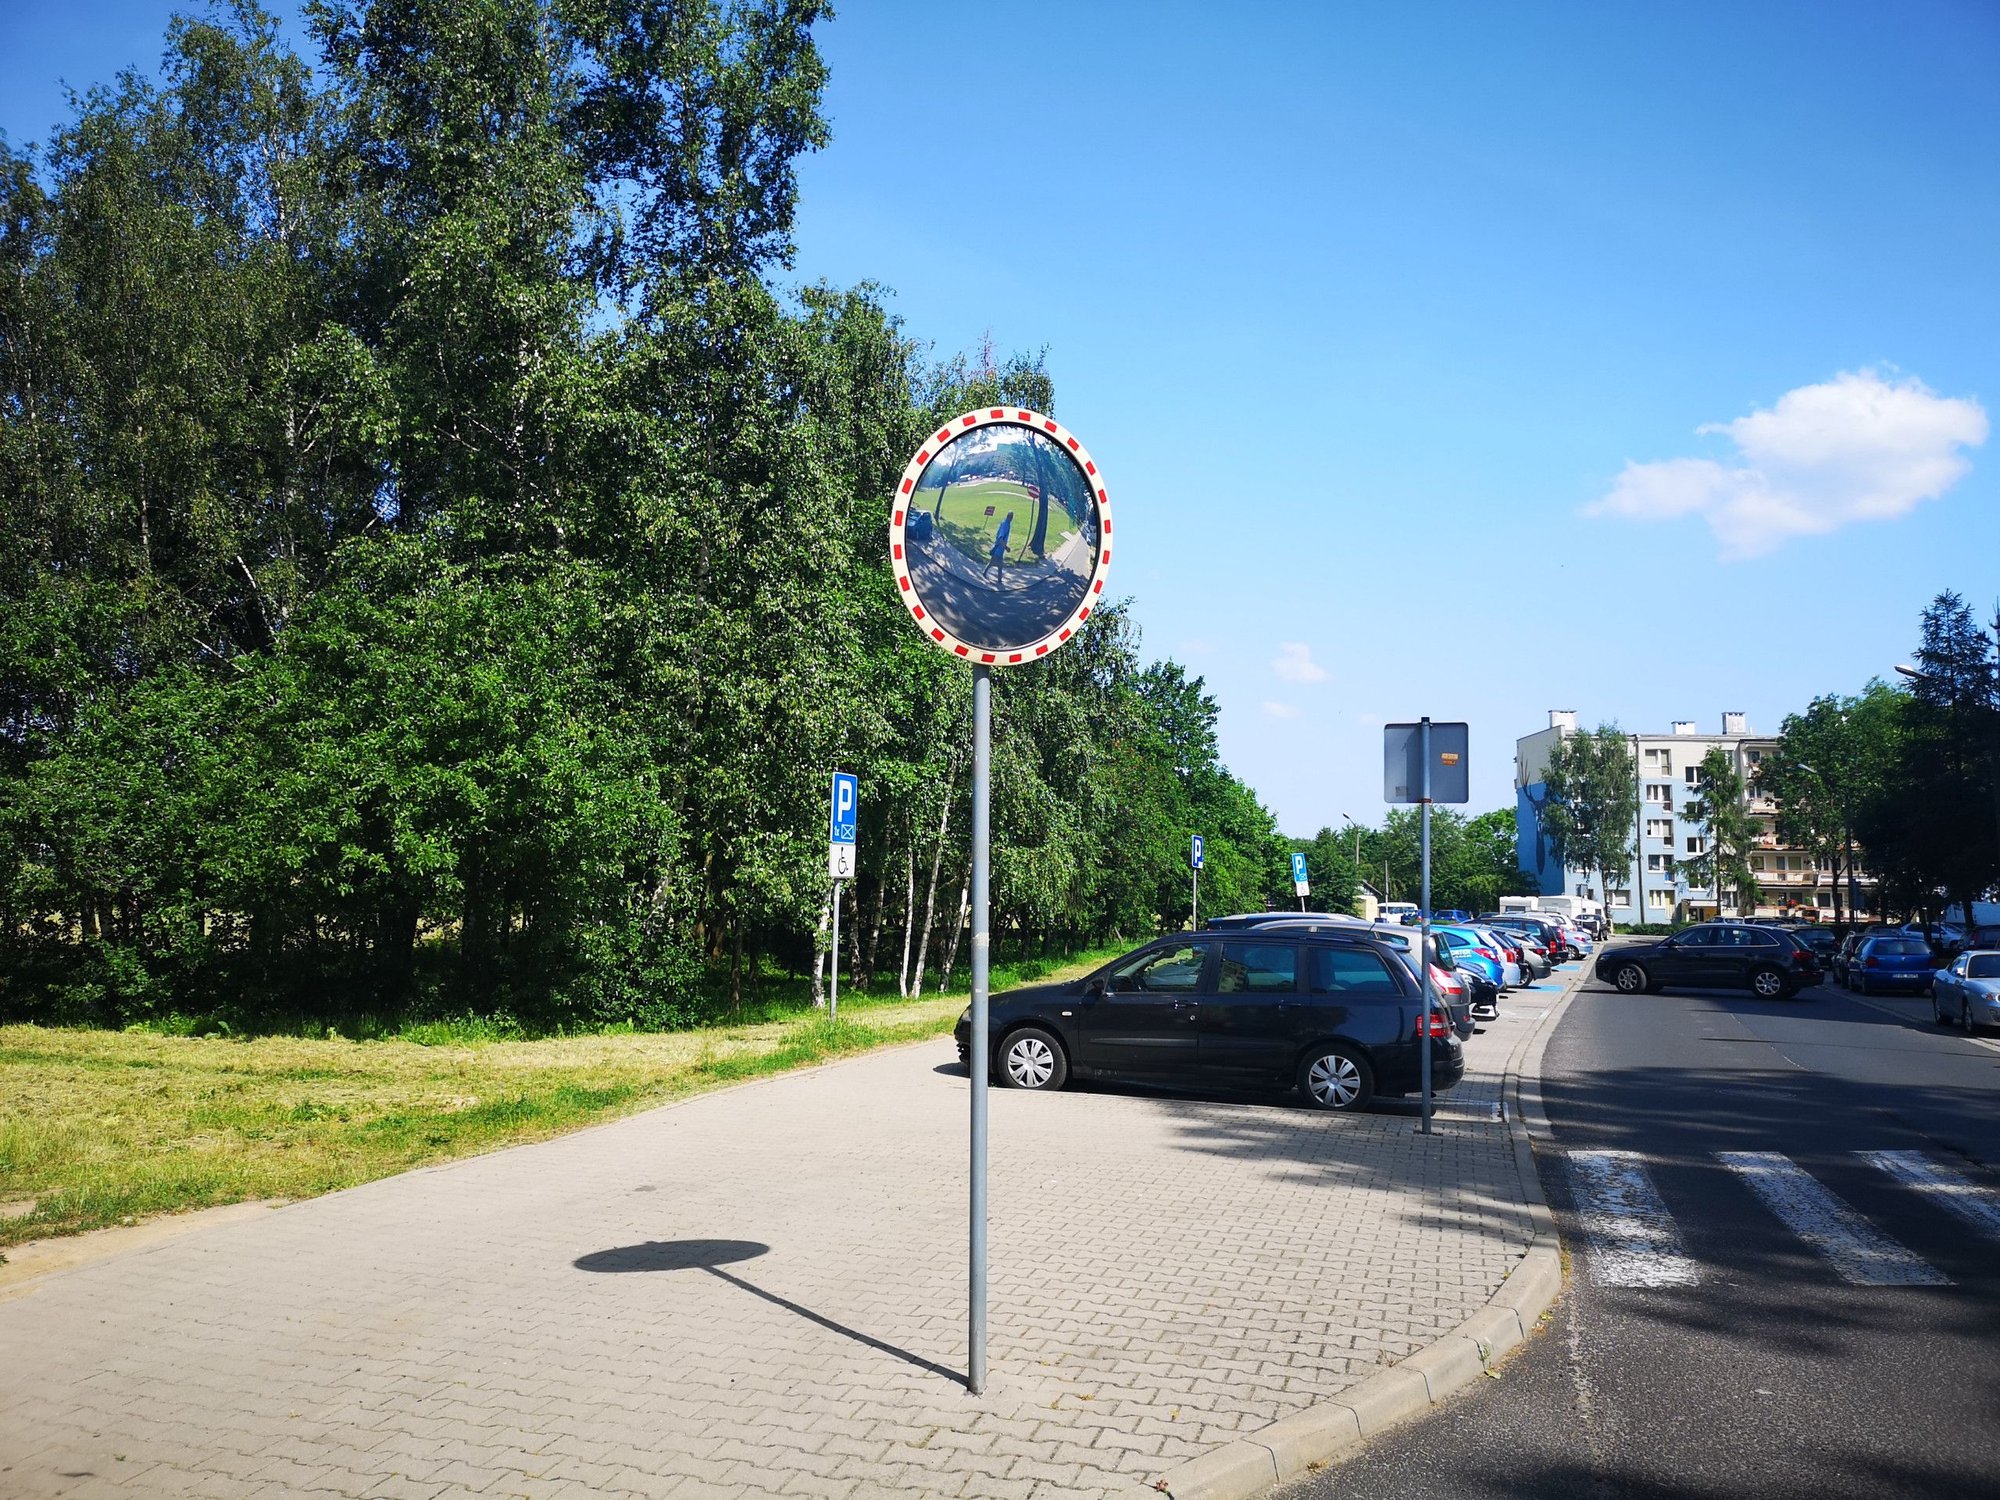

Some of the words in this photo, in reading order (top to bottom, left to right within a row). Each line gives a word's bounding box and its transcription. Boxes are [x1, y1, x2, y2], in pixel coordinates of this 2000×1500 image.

[837, 779, 852, 823] P
[1194, 839, 1202, 864] P
[1294, 855, 1304, 875] P
